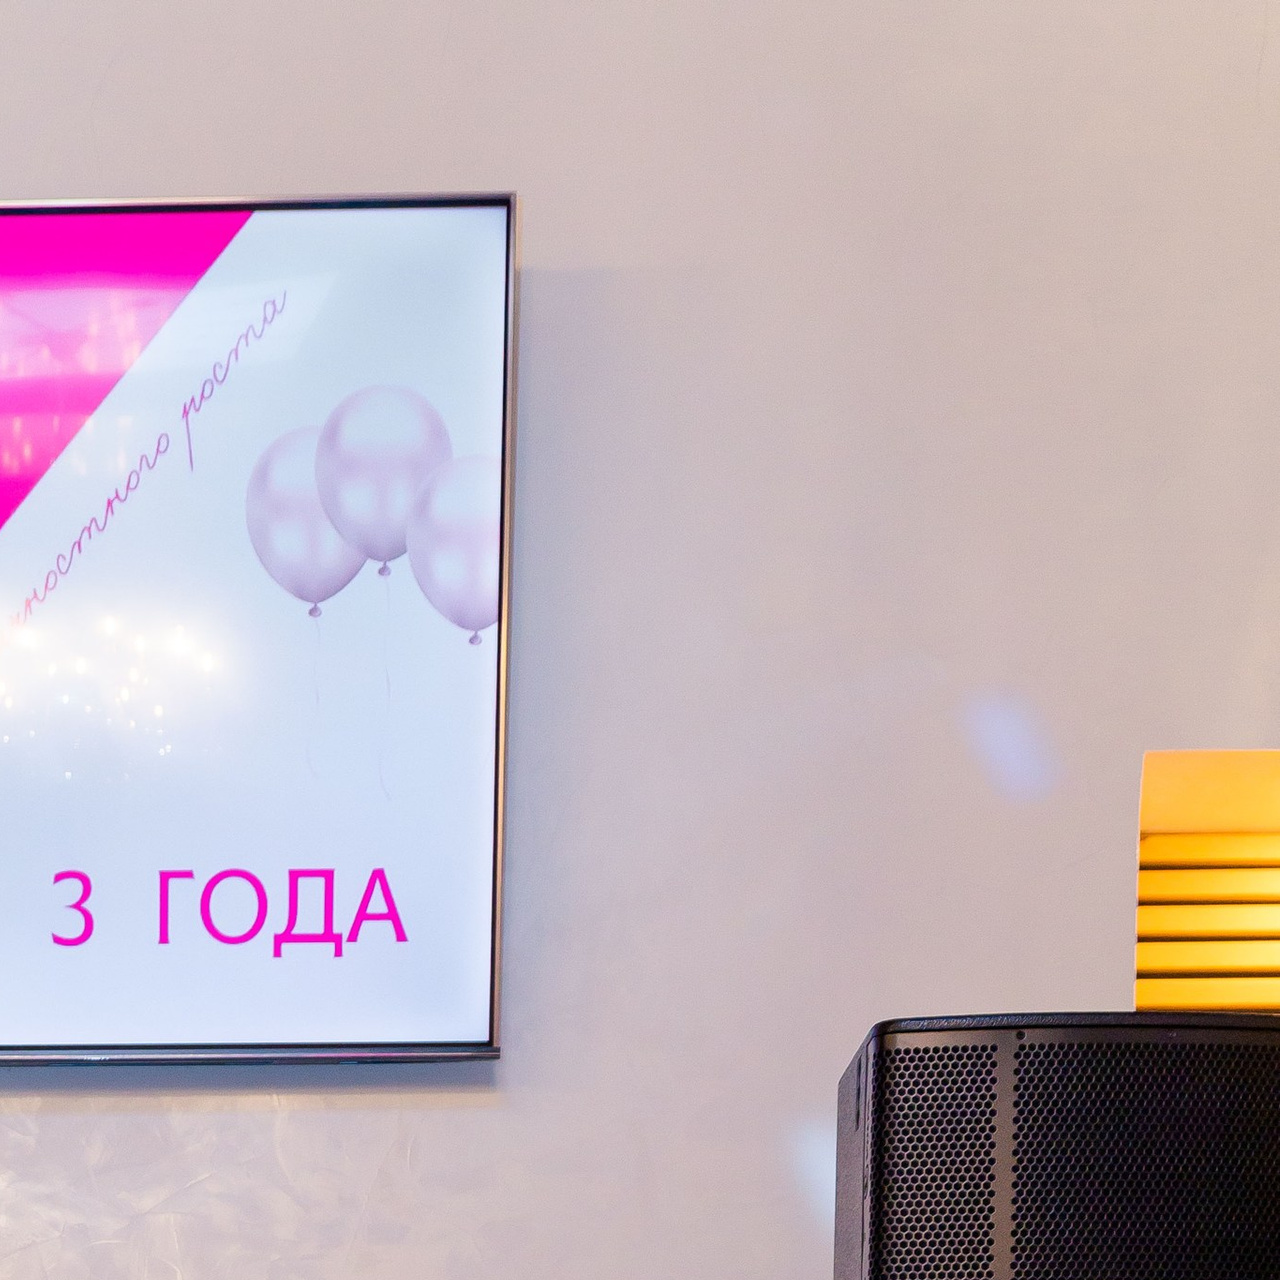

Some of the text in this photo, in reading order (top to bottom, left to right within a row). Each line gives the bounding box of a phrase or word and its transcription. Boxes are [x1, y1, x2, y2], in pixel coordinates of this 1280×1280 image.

[182, 290, 287, 472] роста
[51, 868, 409, 958] 3 ГОДА
